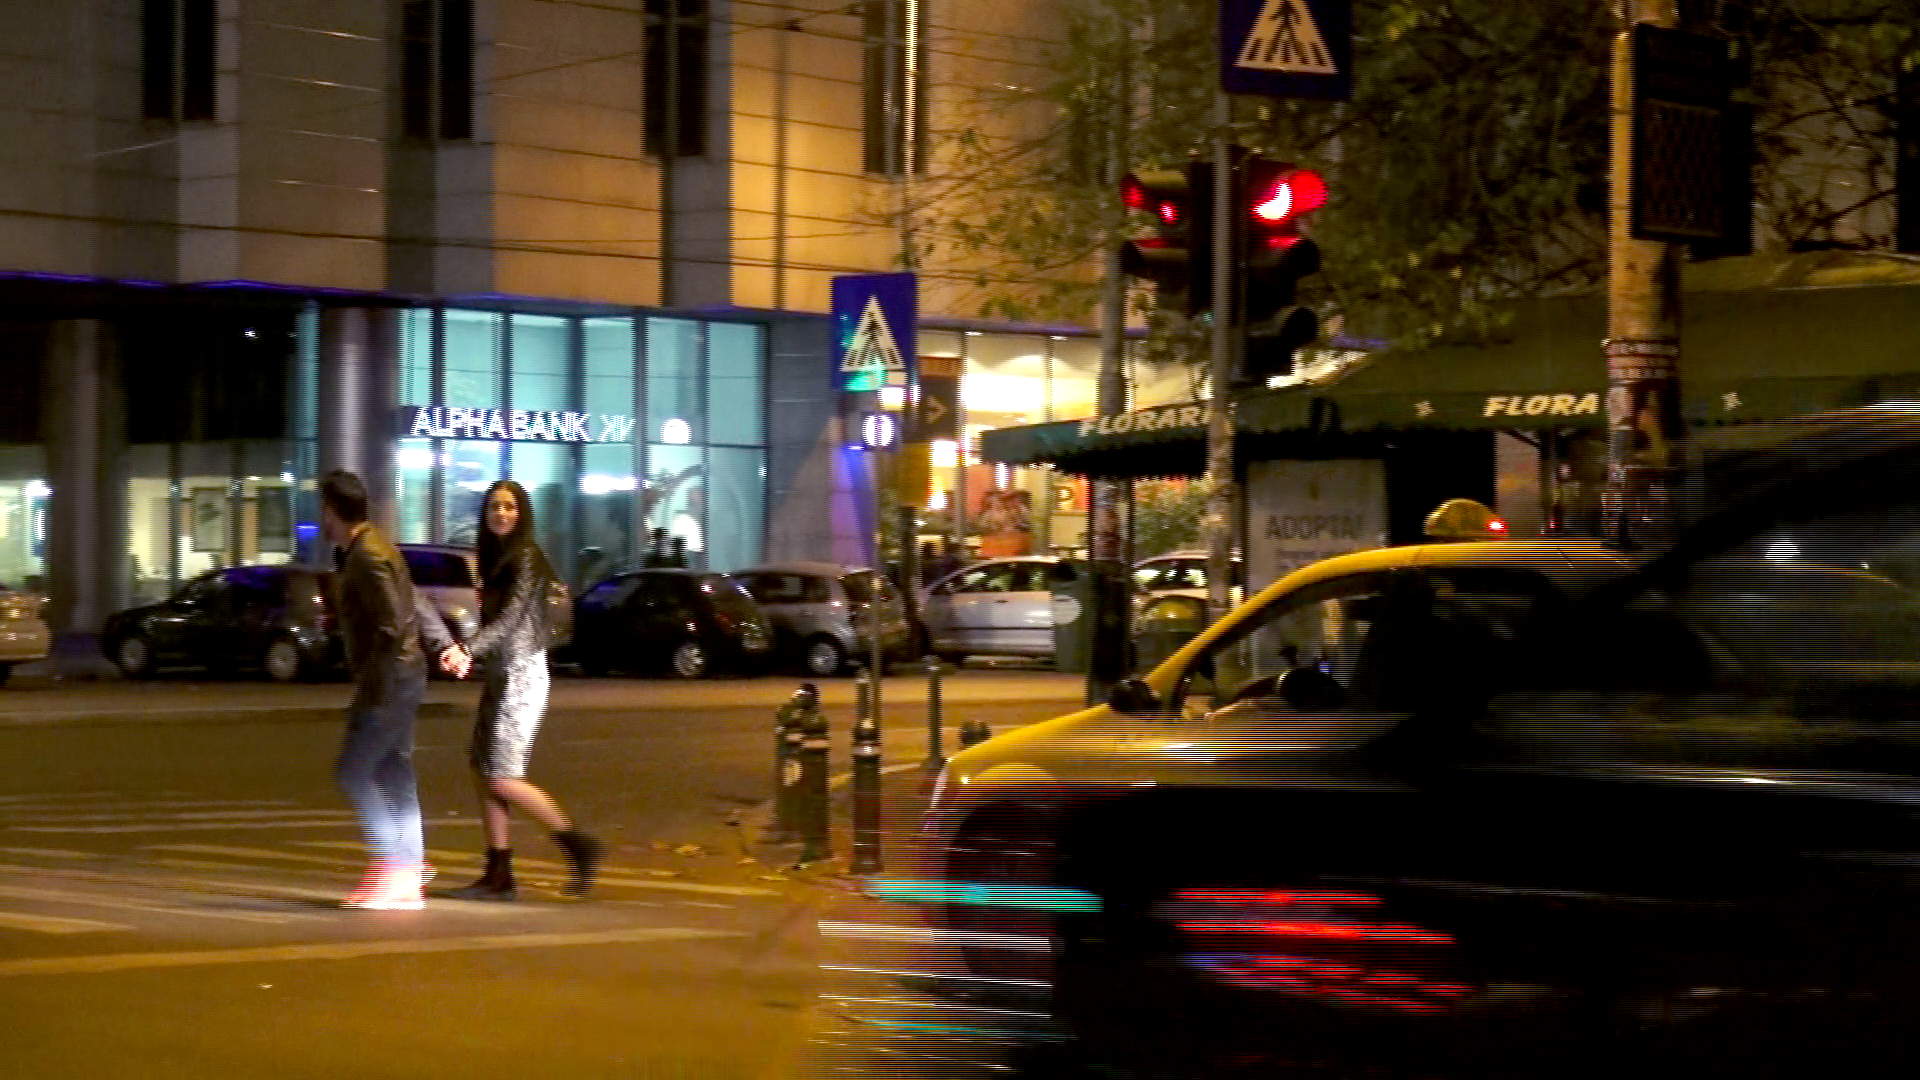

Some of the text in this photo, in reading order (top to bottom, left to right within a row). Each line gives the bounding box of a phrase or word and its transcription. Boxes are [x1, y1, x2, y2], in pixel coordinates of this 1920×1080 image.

[1077, 402, 1214, 438] FLORARI
[1481, 392, 1600, 418] FLORA
[410, 406, 509, 438] ALPHA
[511, 409, 592, 442] BANK
